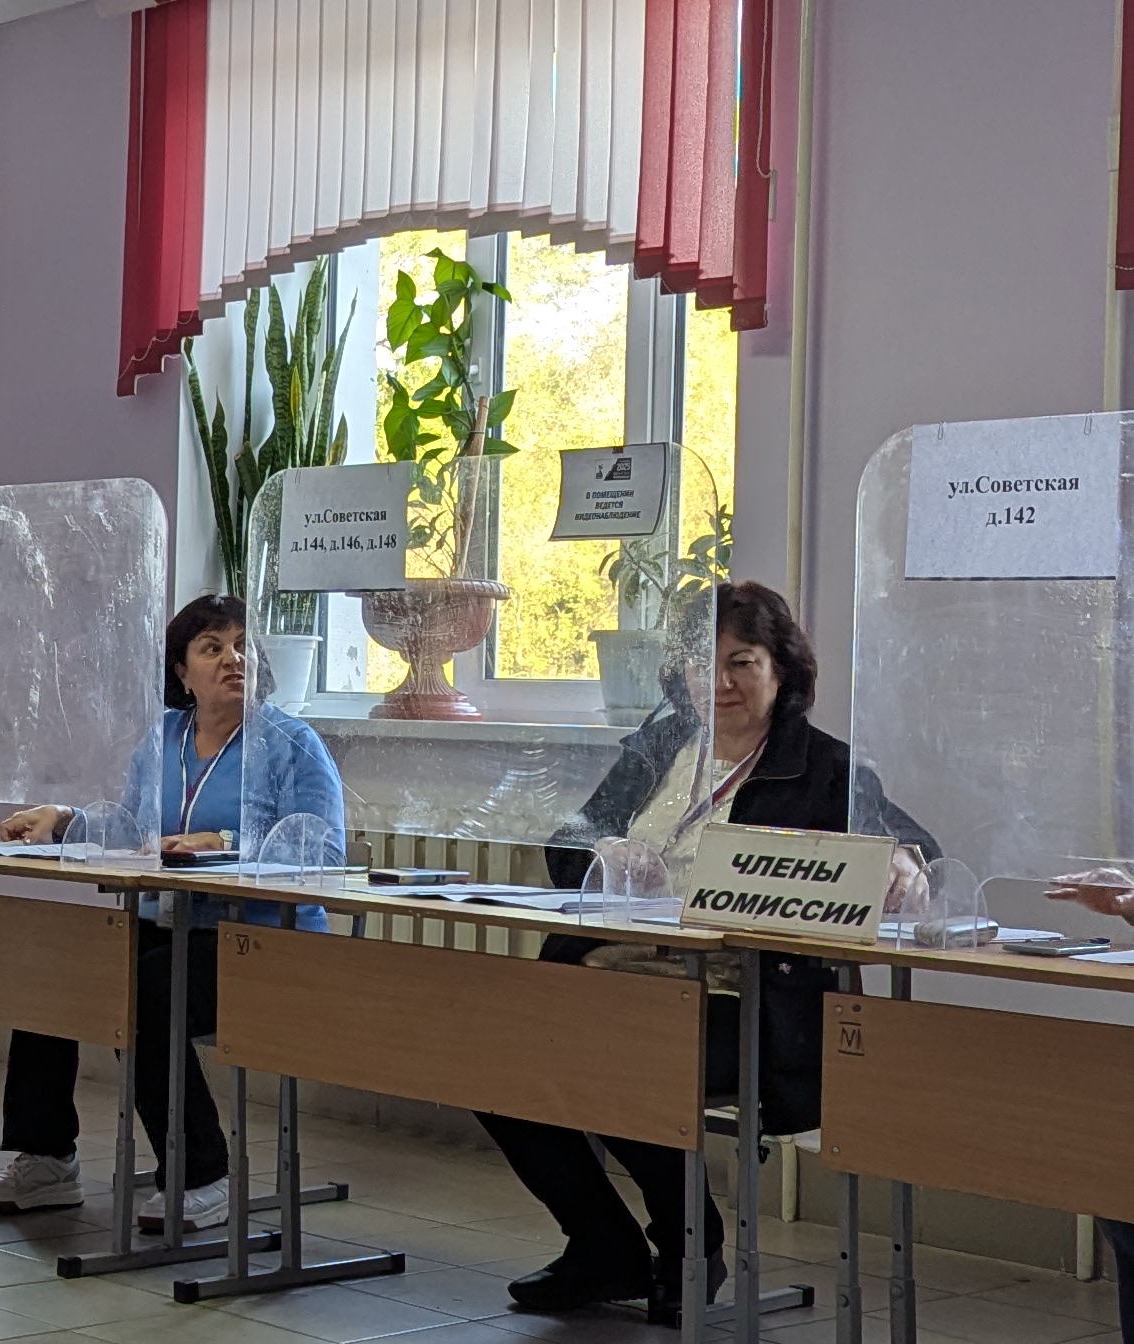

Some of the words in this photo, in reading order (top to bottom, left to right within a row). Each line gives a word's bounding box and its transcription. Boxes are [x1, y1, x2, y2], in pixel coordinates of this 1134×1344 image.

[947, 475, 1080, 499] ул.Советская
[304, 508, 387, 528] ул.Советская
[985, 506, 1036, 528] д.142
[290, 537, 327, 553] д.144,
[329, 535, 364, 552] д.146,
[366, 533, 397, 550] д.148
[731, 853, 847, 884] ЧЛЕНЫ
[689, 888, 872, 927] КОМИССИИ
